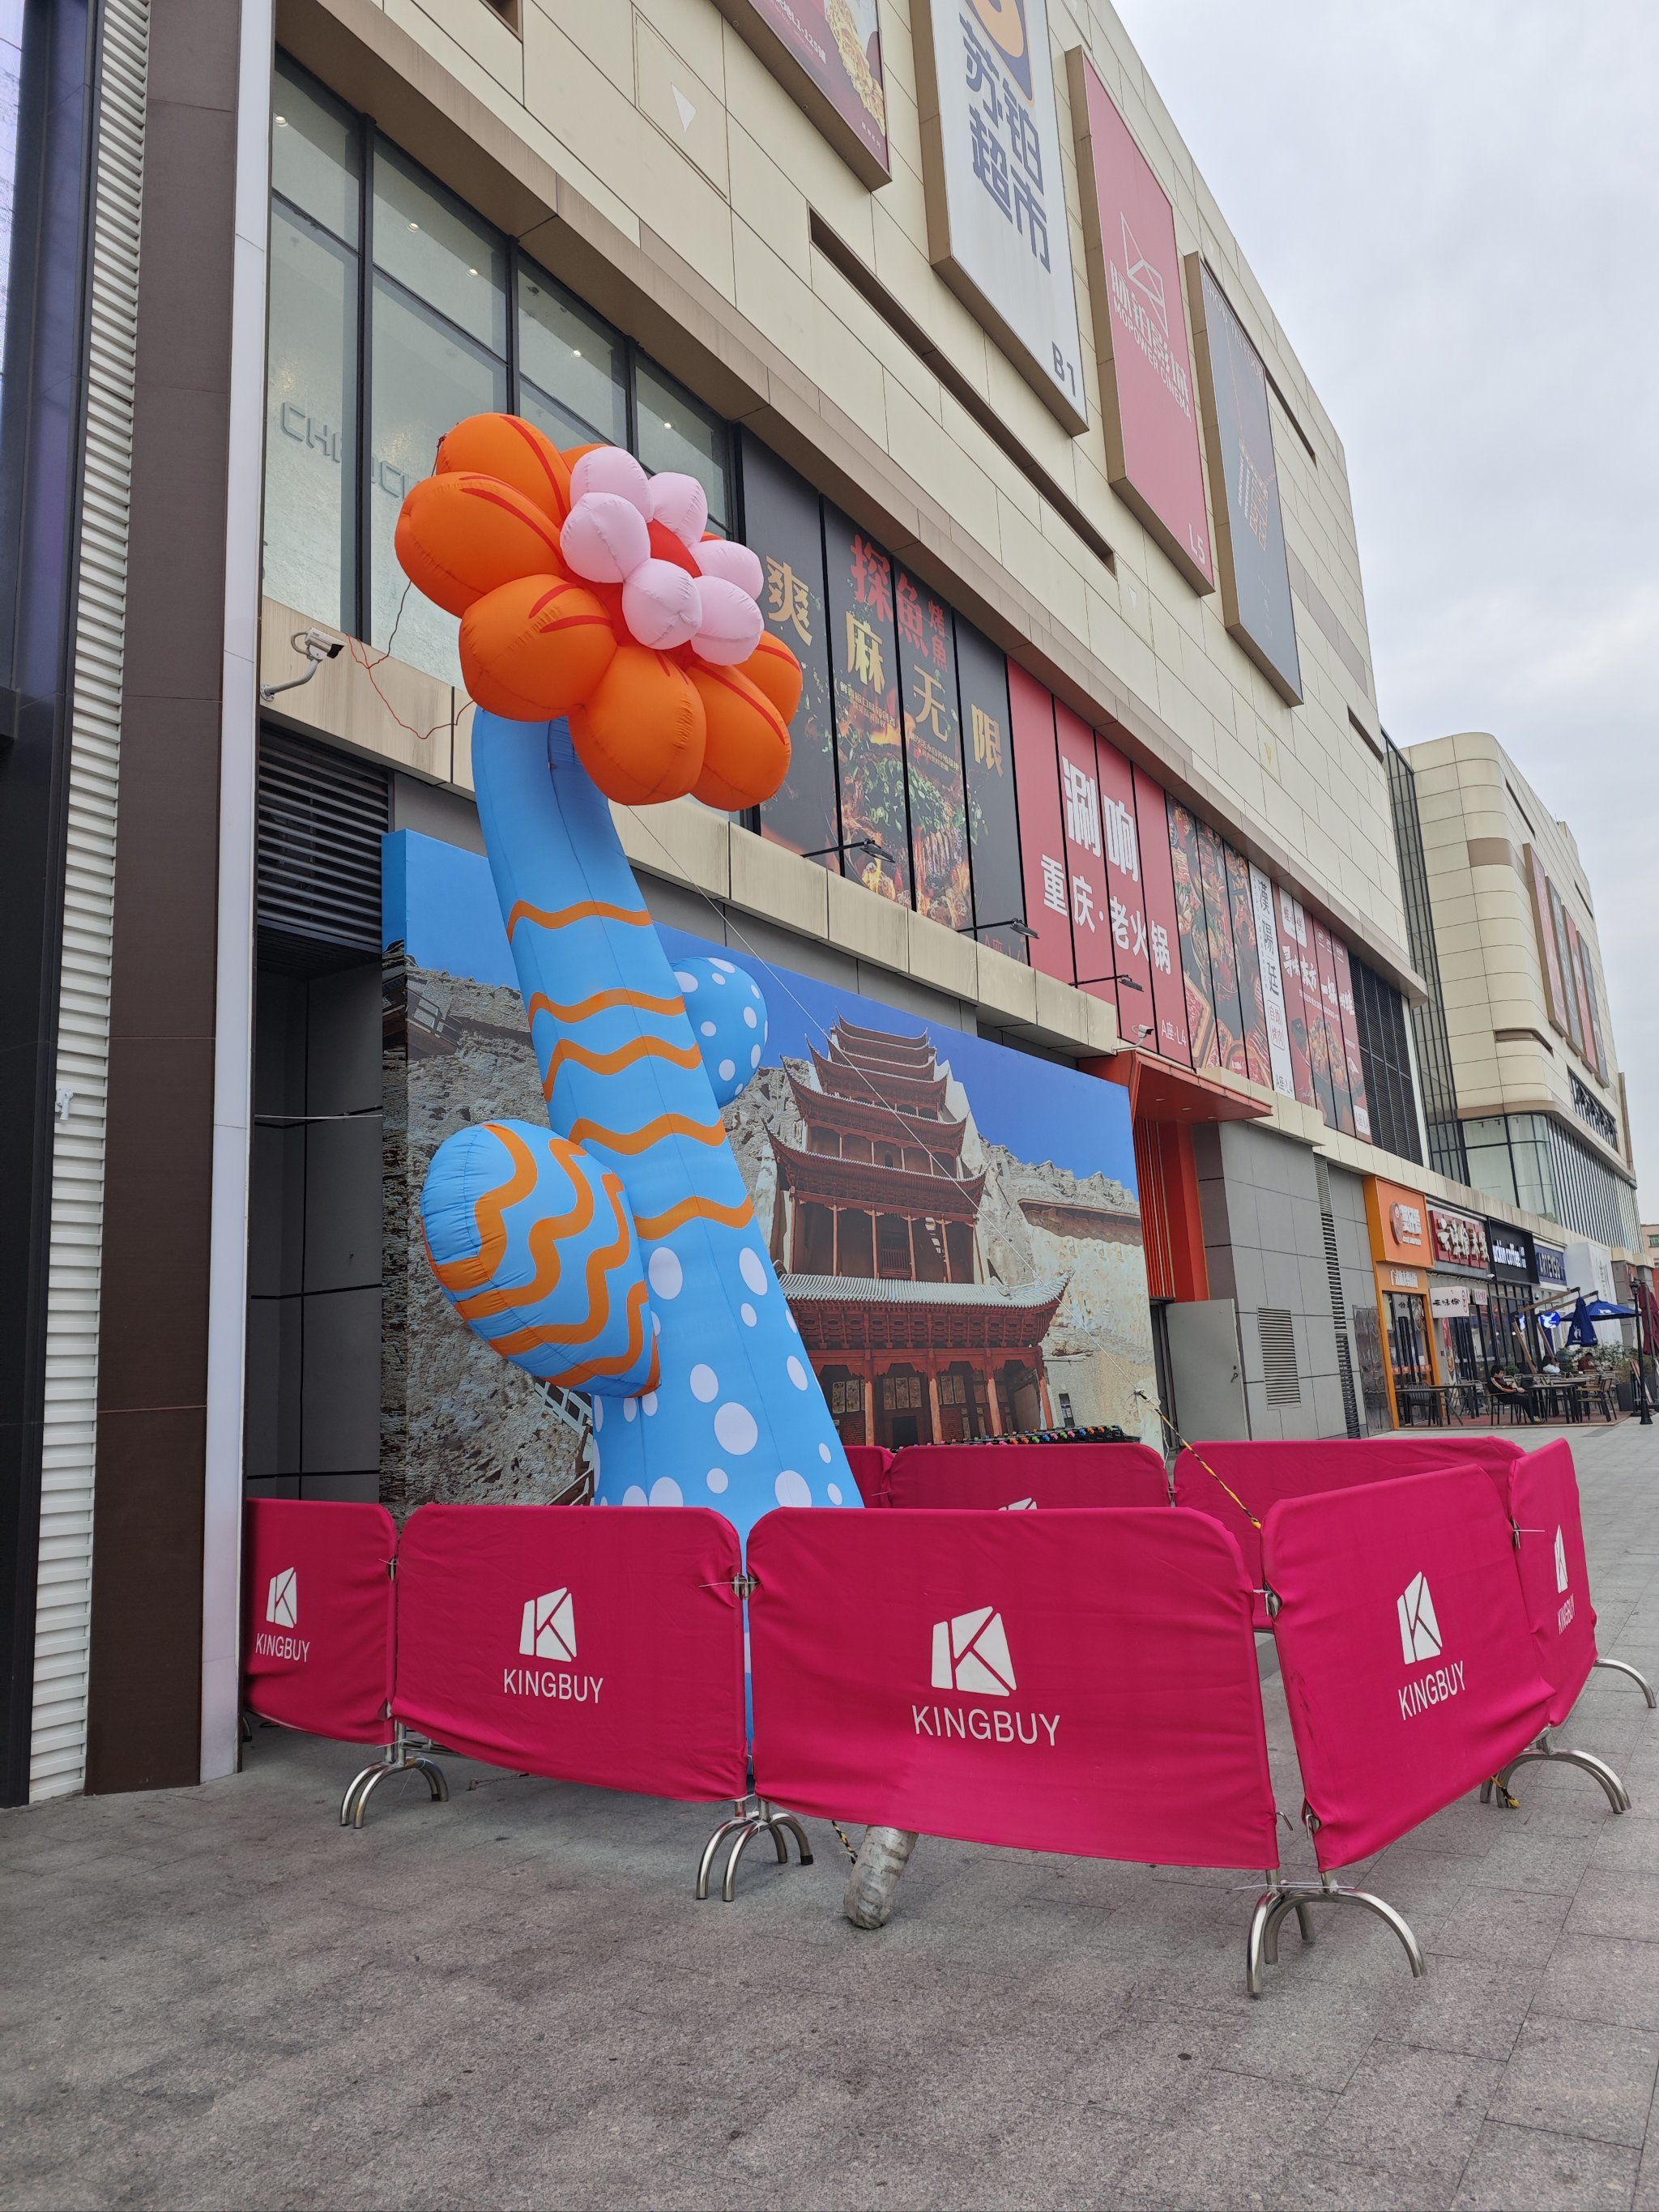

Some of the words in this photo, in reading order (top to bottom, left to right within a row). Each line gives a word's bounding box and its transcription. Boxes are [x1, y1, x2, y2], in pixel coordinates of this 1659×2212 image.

[958, 11, 1044, 196] 苏铂
[969, 103, 1051, 275] 超市
[1051, 340, 1077, 398] B1
[1113, 295, 1158, 375] MOPOWER
[1160, 364, 1192, 422] CINEMA
[1188, 522, 1206, 565] L5
[1061, 755, 1139, 882] 涮响
[255, 1631, 311, 1663] KINGBUY
[502, 1668, 604, 1704] KINGBUY
[1398, 1660, 1465, 1721] KINGBUY
[911, 1704, 1061, 1748] KINGBUY
